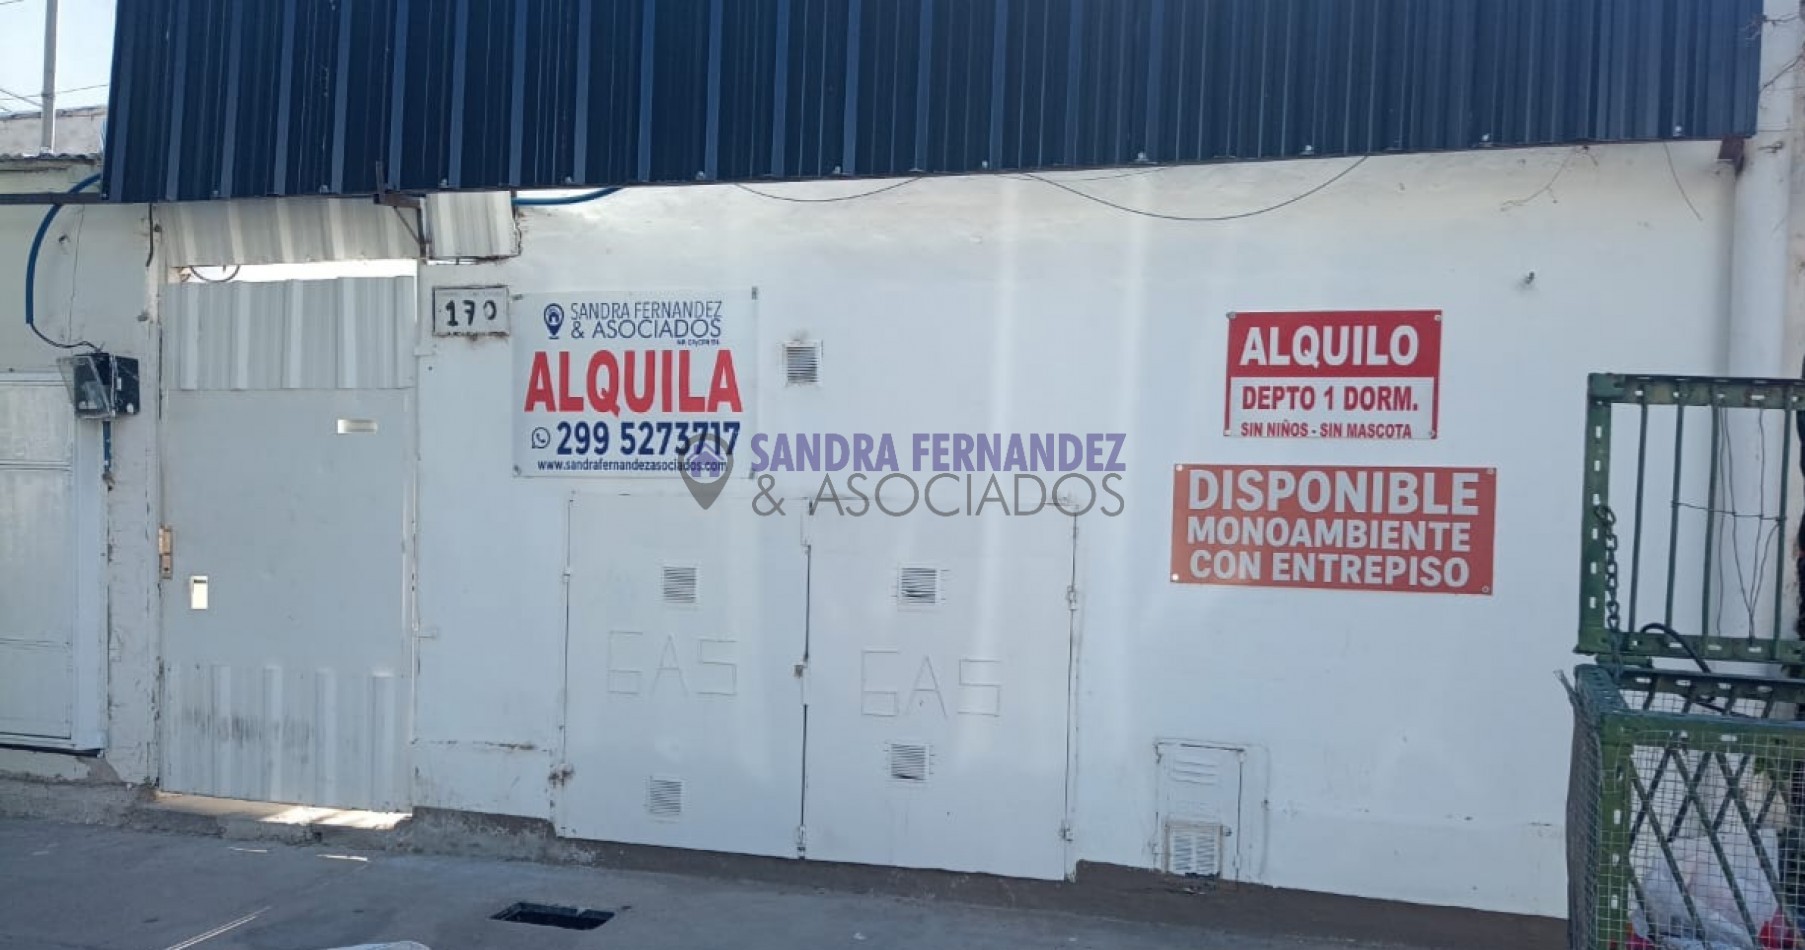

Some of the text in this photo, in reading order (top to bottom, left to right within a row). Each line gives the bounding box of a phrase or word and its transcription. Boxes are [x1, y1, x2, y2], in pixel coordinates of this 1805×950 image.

[445, 299, 498, 327] 170
[570, 301, 723, 321] SANDRA FERNANDEZ
[570, 319, 722, 339] & ASOCIADOS
[1239, 325, 1420, 369] ALQUILO
[523, 349, 744, 418] ALQUILA
[1241, 386, 1419, 412] DEPTO 1 DORM.
[556, 421, 741, 456] 299 5273717
[1240, 422, 1264, 438] SIN
[1266, 419, 1309, 438] NIÑOS
[1319, 422, 1343, 438] SIN
[1346, 423, 1412, 439] MASCOTA
[537, 458, 728, 472] www.sandrafernandezasociados.com
[1187, 469, 1480, 515] DISPONIBLE
[1187, 516, 1471, 552] MONOAMBIENTE
[1189, 550, 1470, 587] CON ENTREPISO
